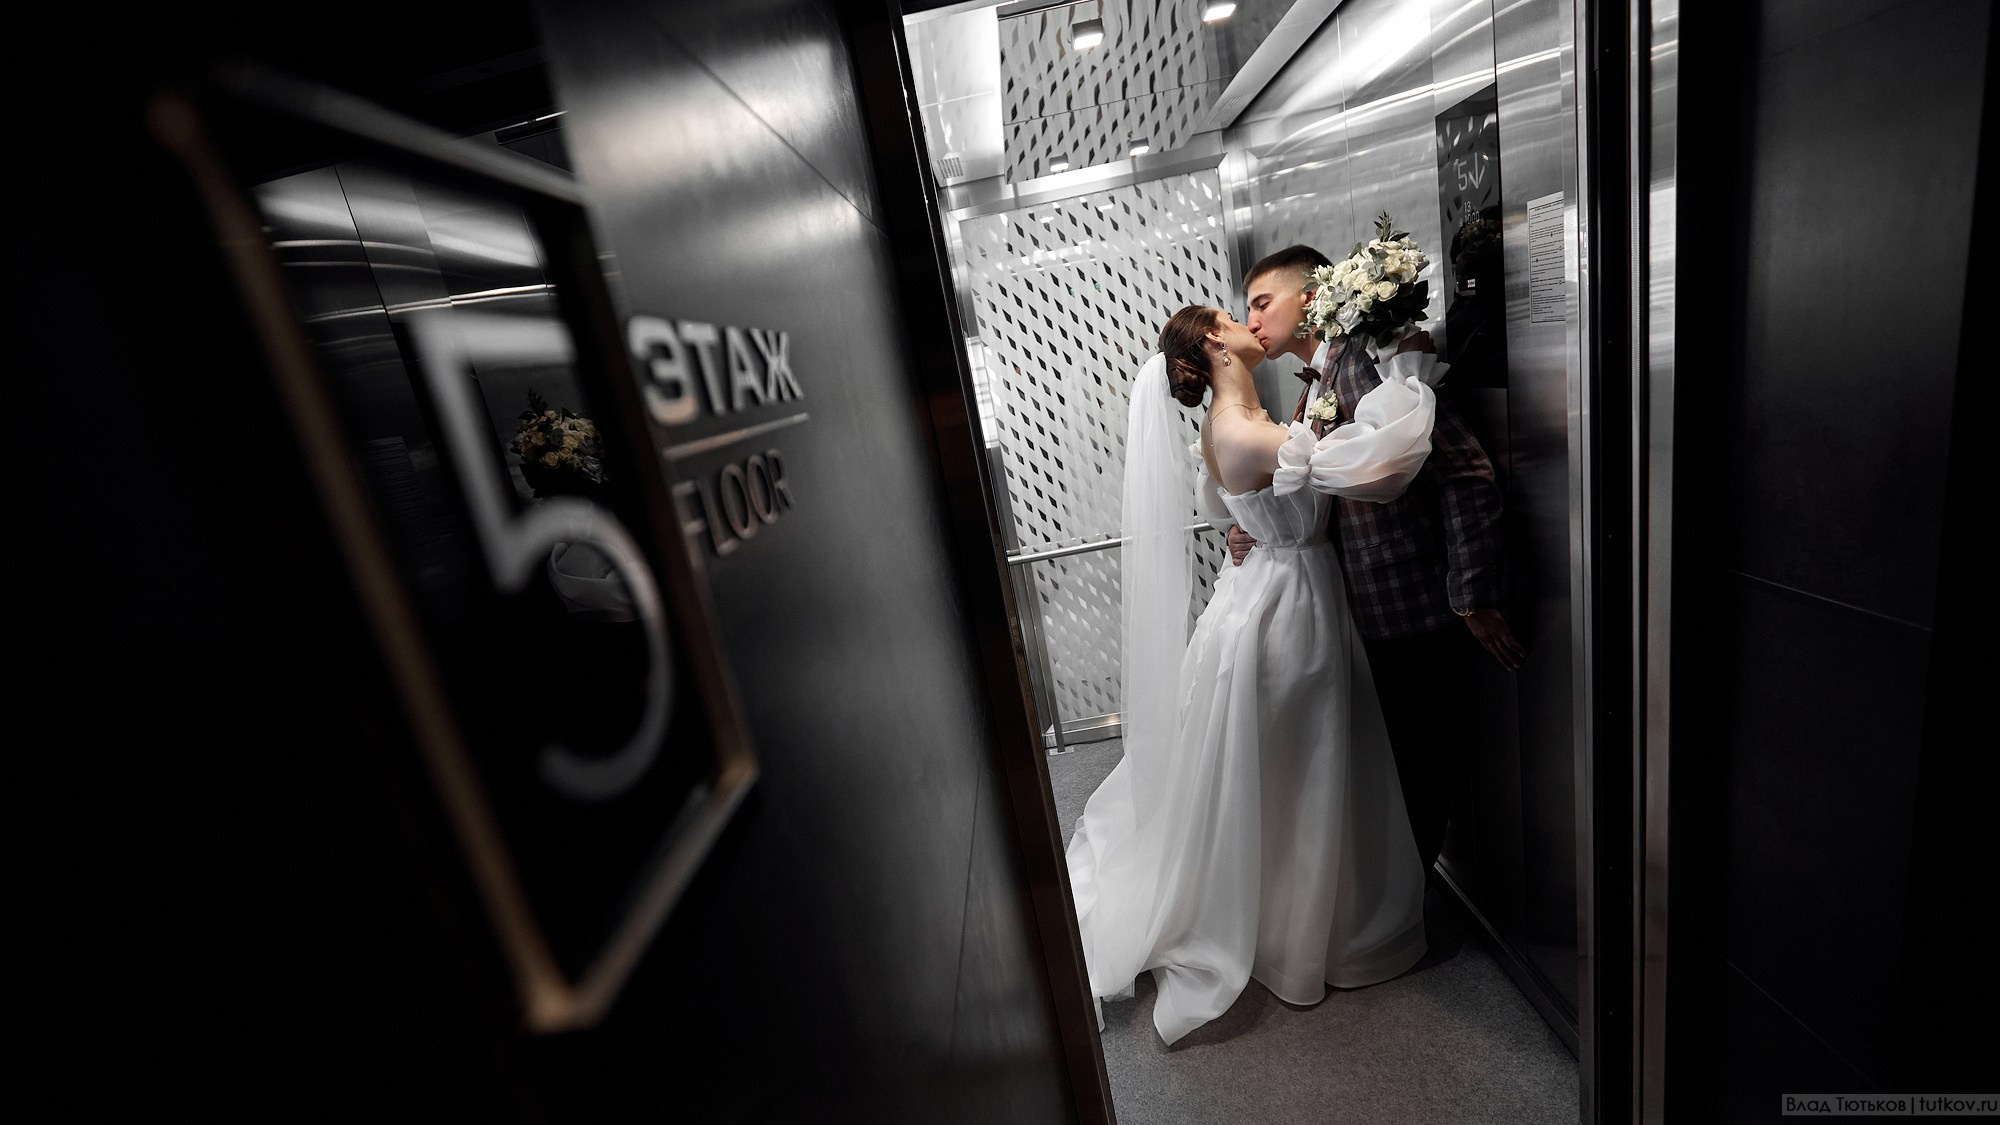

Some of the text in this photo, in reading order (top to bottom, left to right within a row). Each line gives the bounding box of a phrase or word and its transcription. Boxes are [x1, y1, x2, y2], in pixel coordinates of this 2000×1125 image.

[1457, 160, 1468, 191] 5
[627, 315, 804, 426] ЭТАЖ
[405, 312, 674, 796] 5
[671, 449, 796, 578] FLOOR
